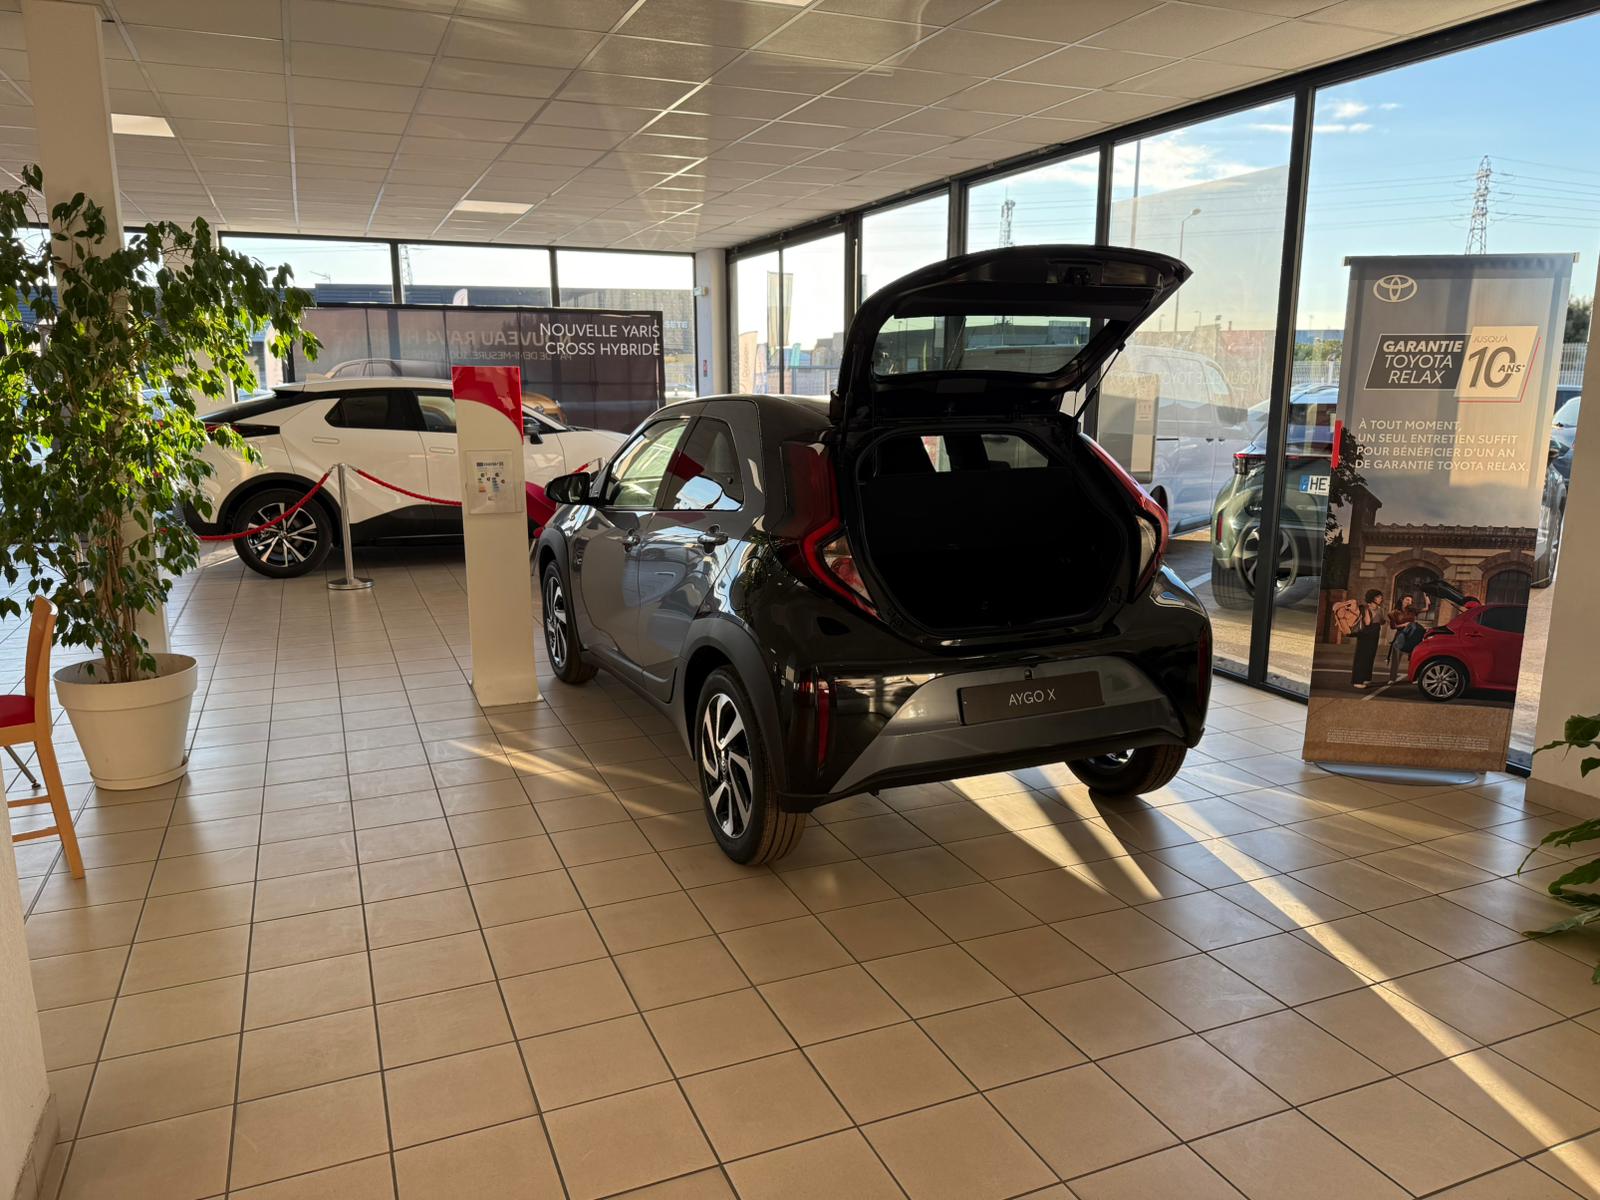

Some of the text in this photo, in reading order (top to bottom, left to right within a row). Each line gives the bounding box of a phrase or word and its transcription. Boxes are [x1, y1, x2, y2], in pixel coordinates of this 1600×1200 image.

[540, 323, 660, 338] NOUVELLE YARIS
[545, 342, 660, 356] CROSS HYBRIDE
[1383, 340, 1464, 353] GARANTIE
[1384, 354, 1453, 369] TOYOTA
[1468, 346, 1516, 388] 10
[1388, 370, 1446, 384] RELAX
[1358, 417, 1462, 433] À TOUT MOMENT,
[1357, 433, 1518, 445] UN SEUL ENTRETIEN SUFFIT
[1356, 445, 1516, 458] POUR BÉNÉFICIER D'UN AN
[1355, 459, 1529, 472] DE GARANTIE TOYOTA RELAX.
[1009, 688, 1056, 707] AYGO X
